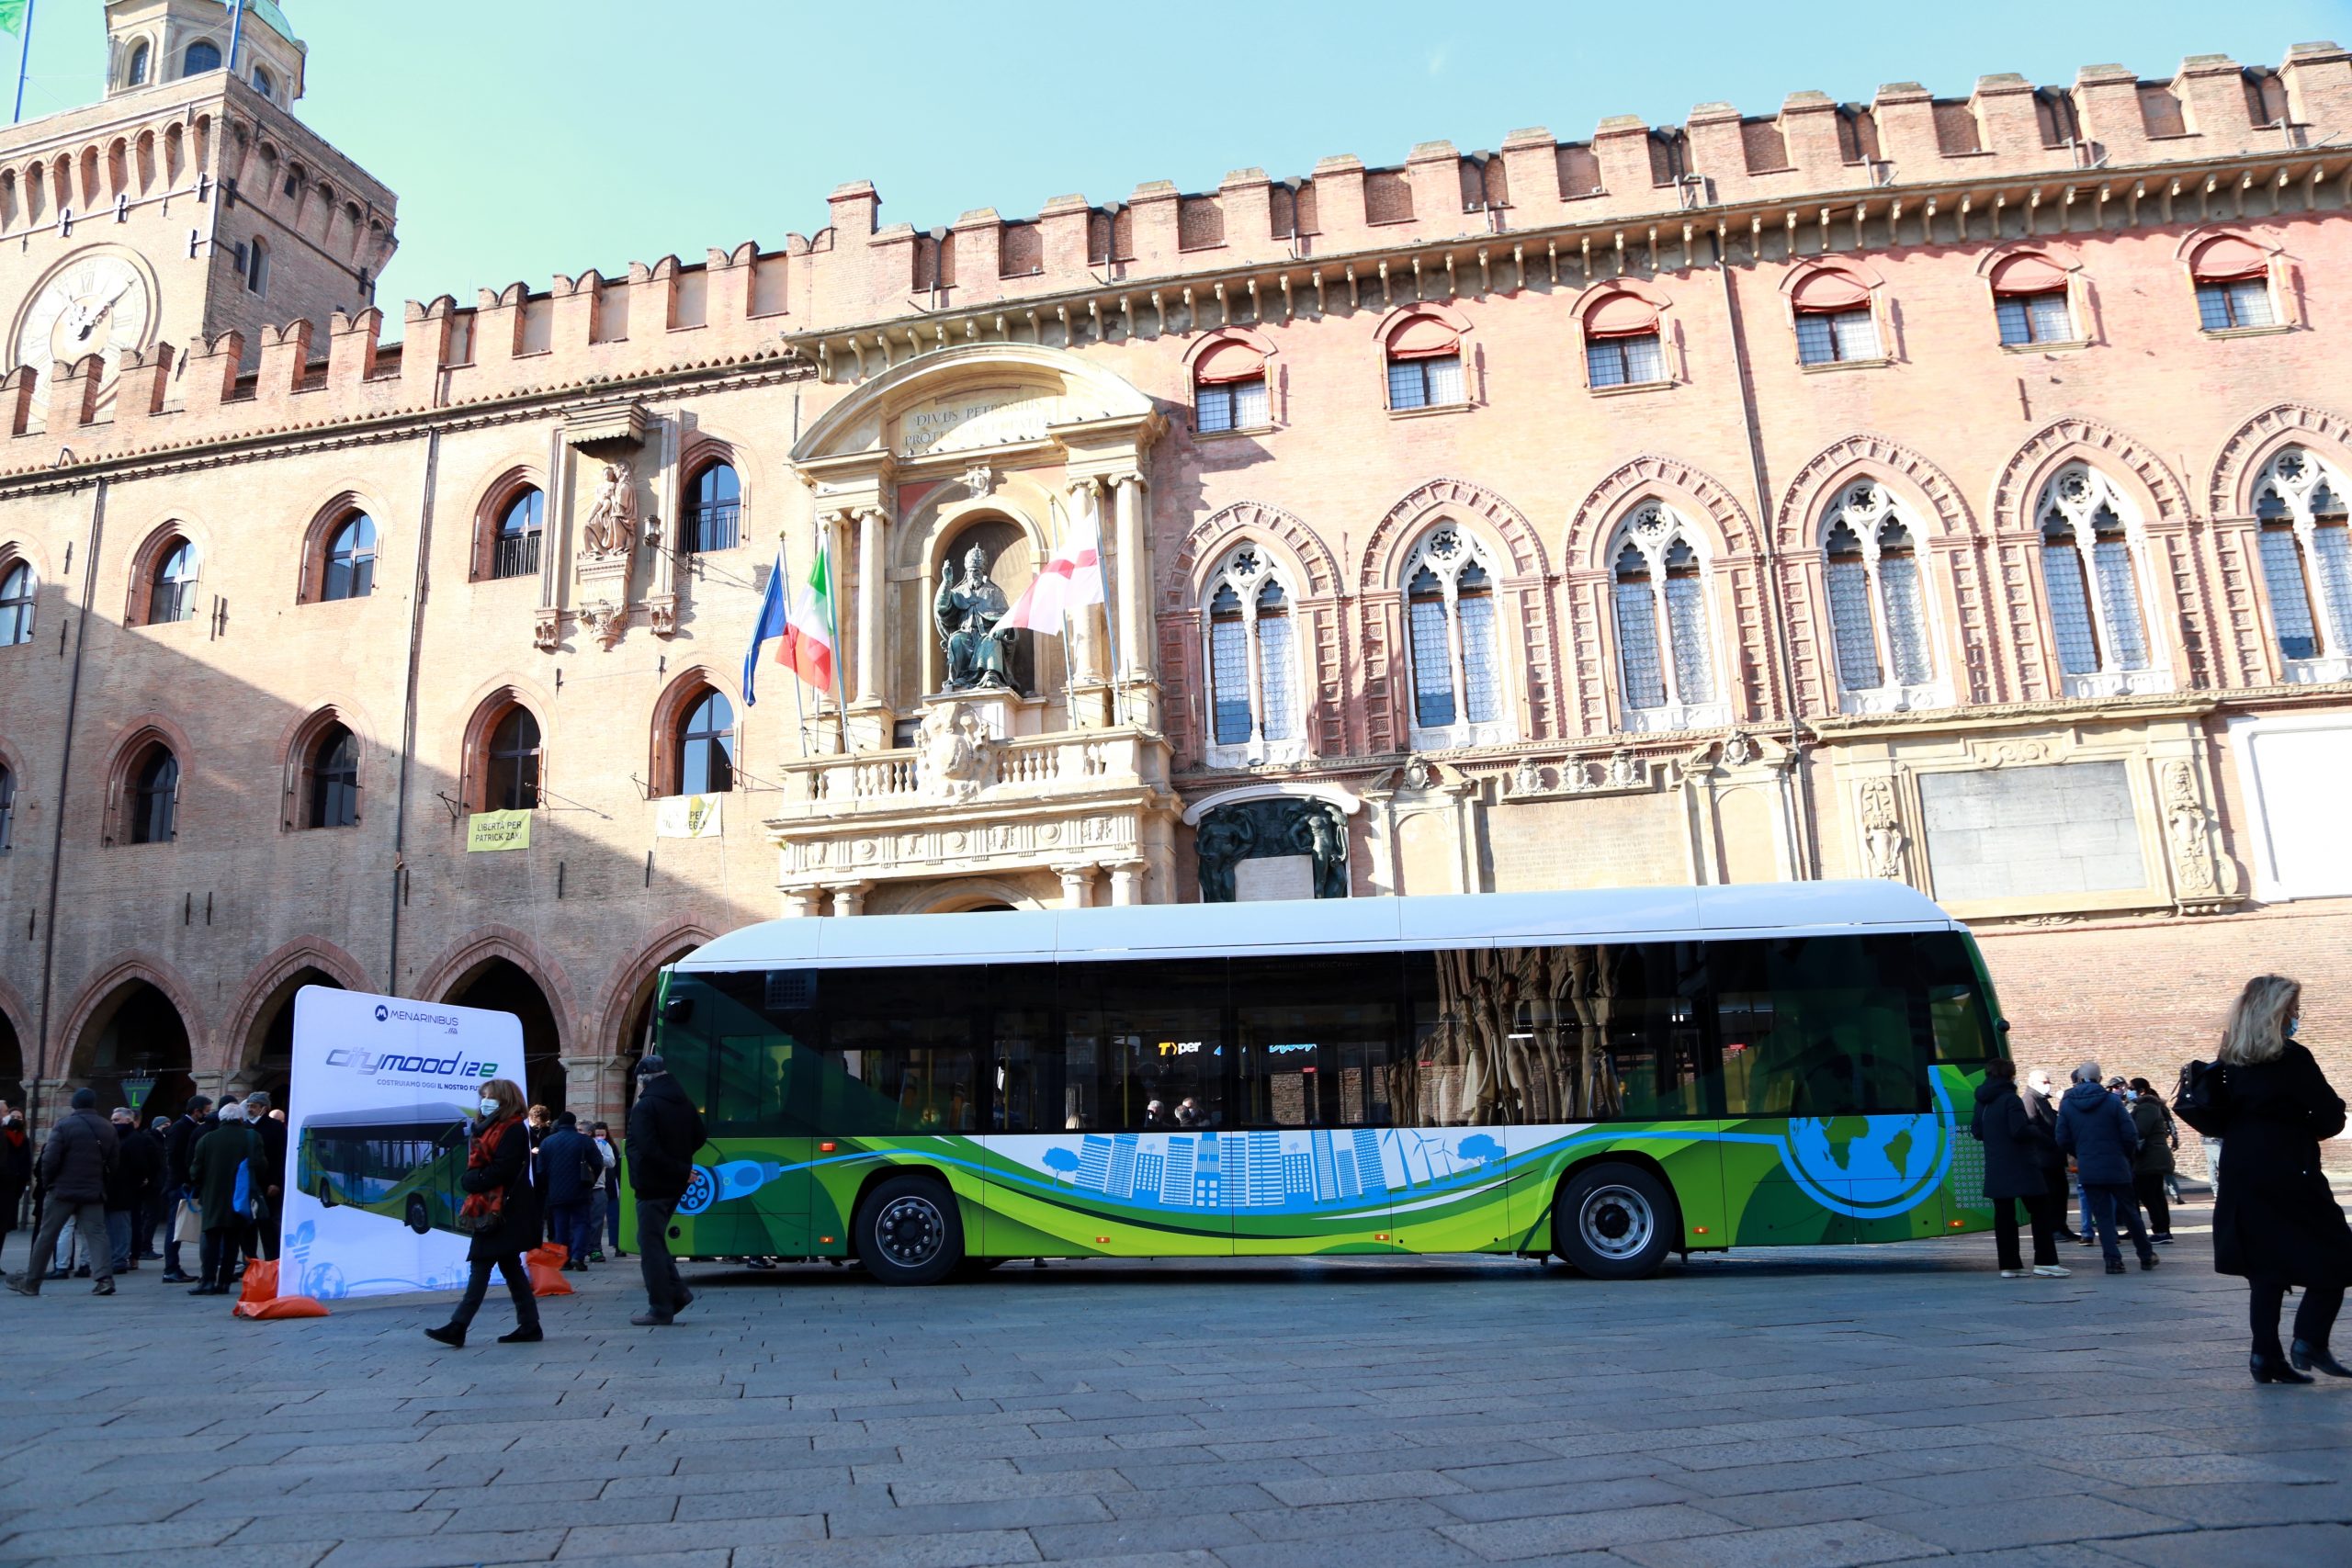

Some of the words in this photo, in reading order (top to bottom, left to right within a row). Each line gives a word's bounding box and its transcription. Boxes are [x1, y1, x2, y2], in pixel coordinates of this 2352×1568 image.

[477, 820, 504, 831] LIBERTÀ
[506, 820, 522, 829] PER
[475, 832, 503, 842] PATRICK
[390, 1010, 458, 1026] MENARINIBUS
[326, 1047, 462, 1076] citymood
[377, 1079, 421, 1088] COSTRUIAMO
